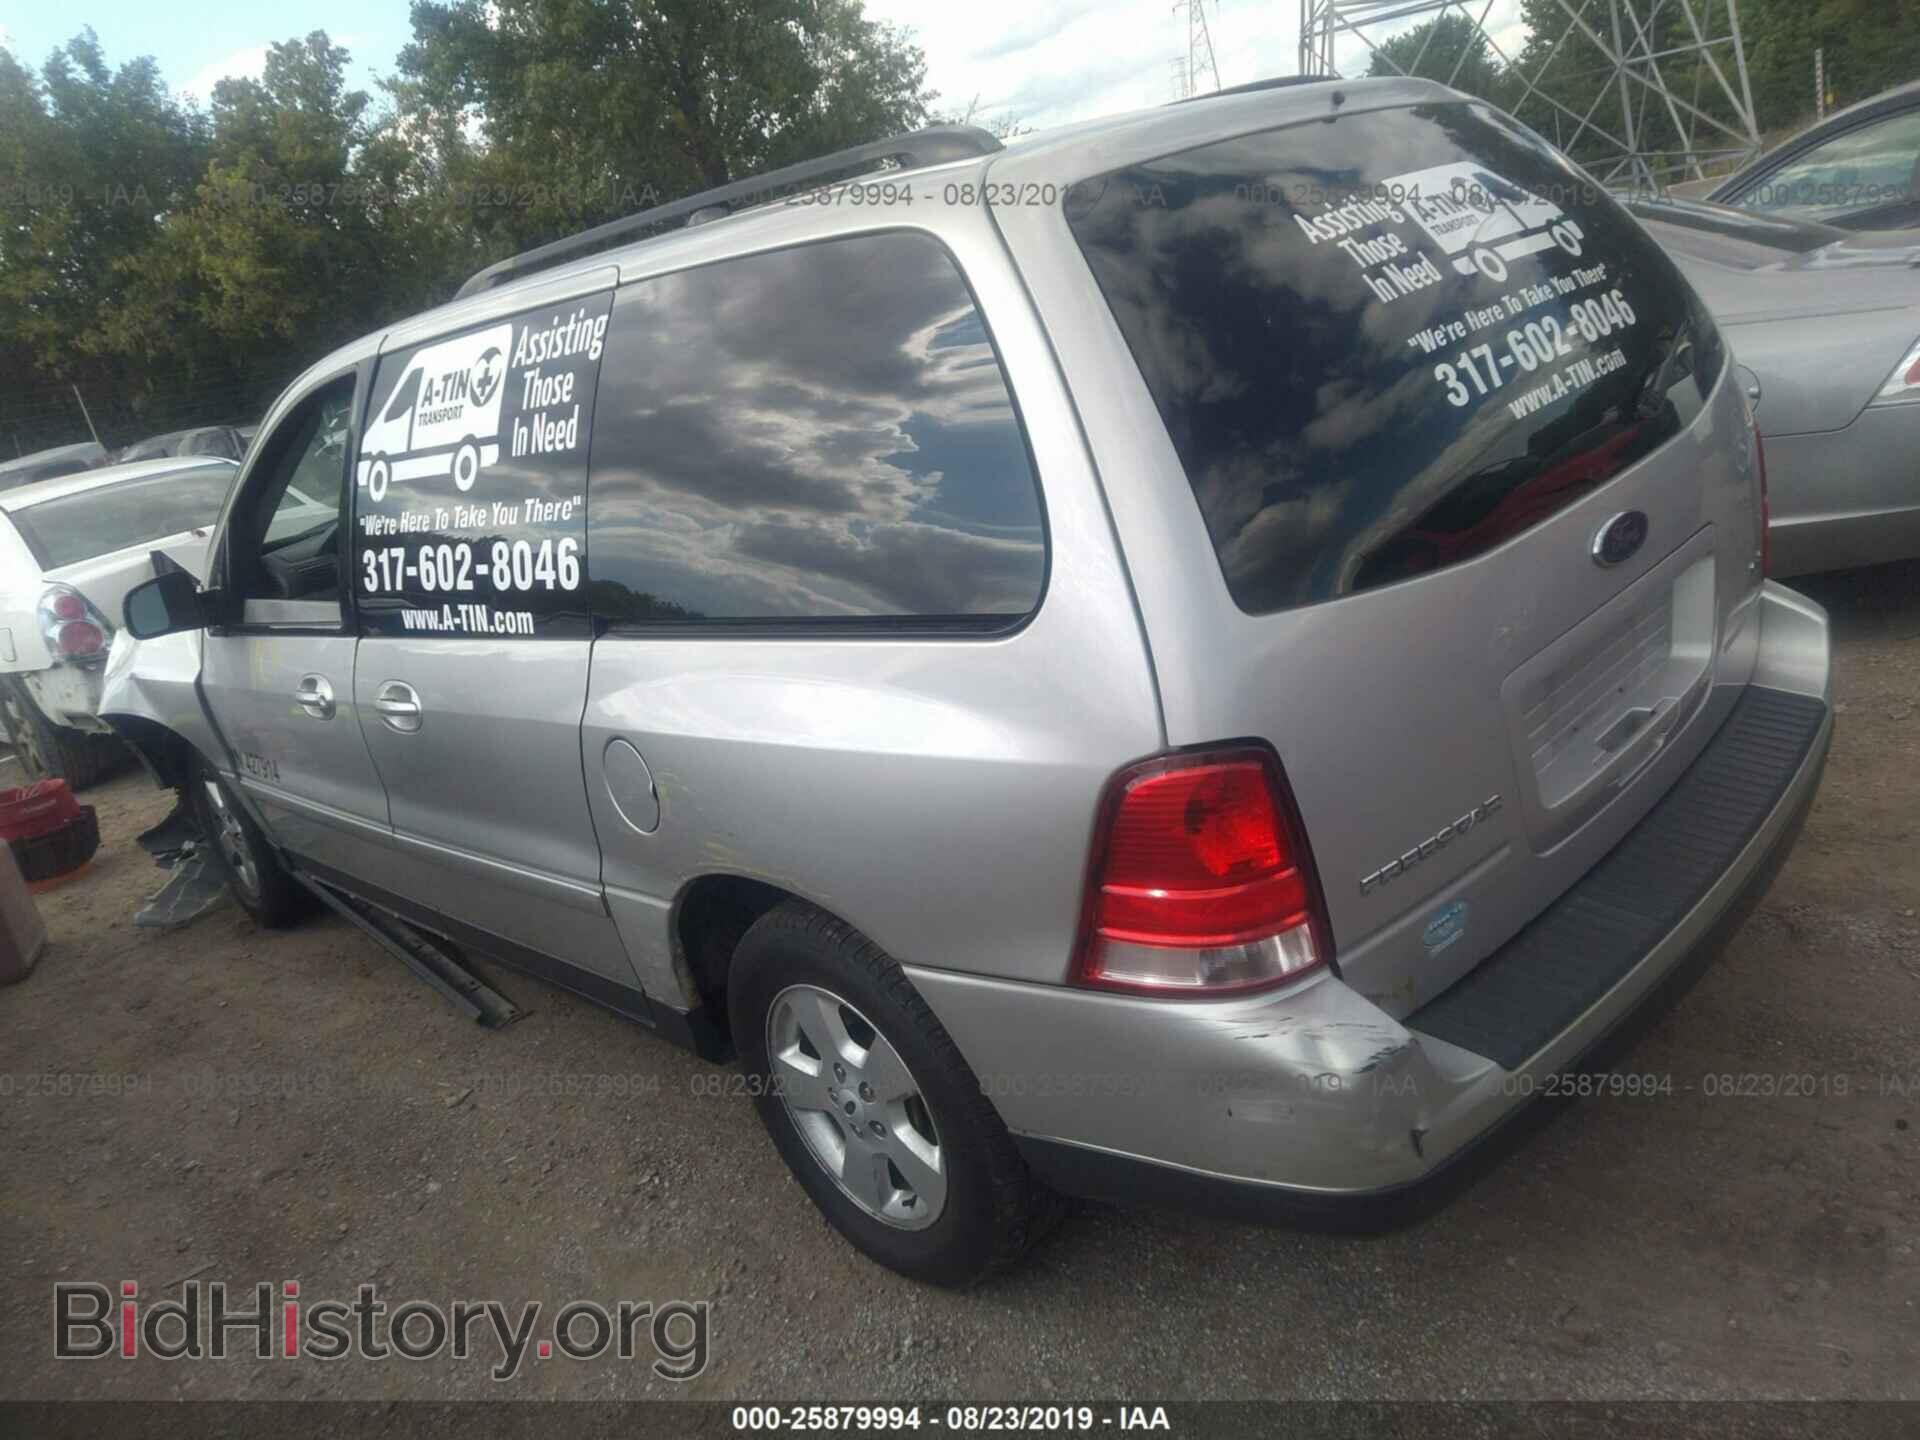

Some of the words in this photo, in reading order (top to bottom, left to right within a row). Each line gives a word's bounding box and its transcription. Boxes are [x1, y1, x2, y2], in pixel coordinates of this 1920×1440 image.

[1294, 194, 1405, 245] Assisting
[1337, 231, 1408, 268] Those
[1362, 272, 1396, 304] In
[1389, 251, 1442, 297] Need
[511, 307, 609, 369] Assisting
[1407, 323, 1466, 354] "We're
[1466, 307, 1505, 334] Here
[1501, 296, 1523, 315] To
[1520, 283, 1554, 306] Take
[1550, 270, 1577, 296] You
[1434, 288, 1636, 407] 317-602-8046
[420, 367, 471, 408] A-TIN
[521, 367, 575, 411] Those
[1508, 346, 1627, 420] www.A-TIN.com
[418, 405, 464, 428] TRANSPORT
[511, 415, 529, 457] In
[530, 404, 580, 456] Need
[359, 513, 397, 536] "We're
[399, 511, 431, 534] Here
[435, 508, 450, 531] To
[453, 504, 487, 529] Take
[491, 500, 518, 526] You
[524, 495, 582, 524] There"
[362, 536, 581, 592] 317-602-8046
[400, 603, 535, 635] www.A-TIN.com
